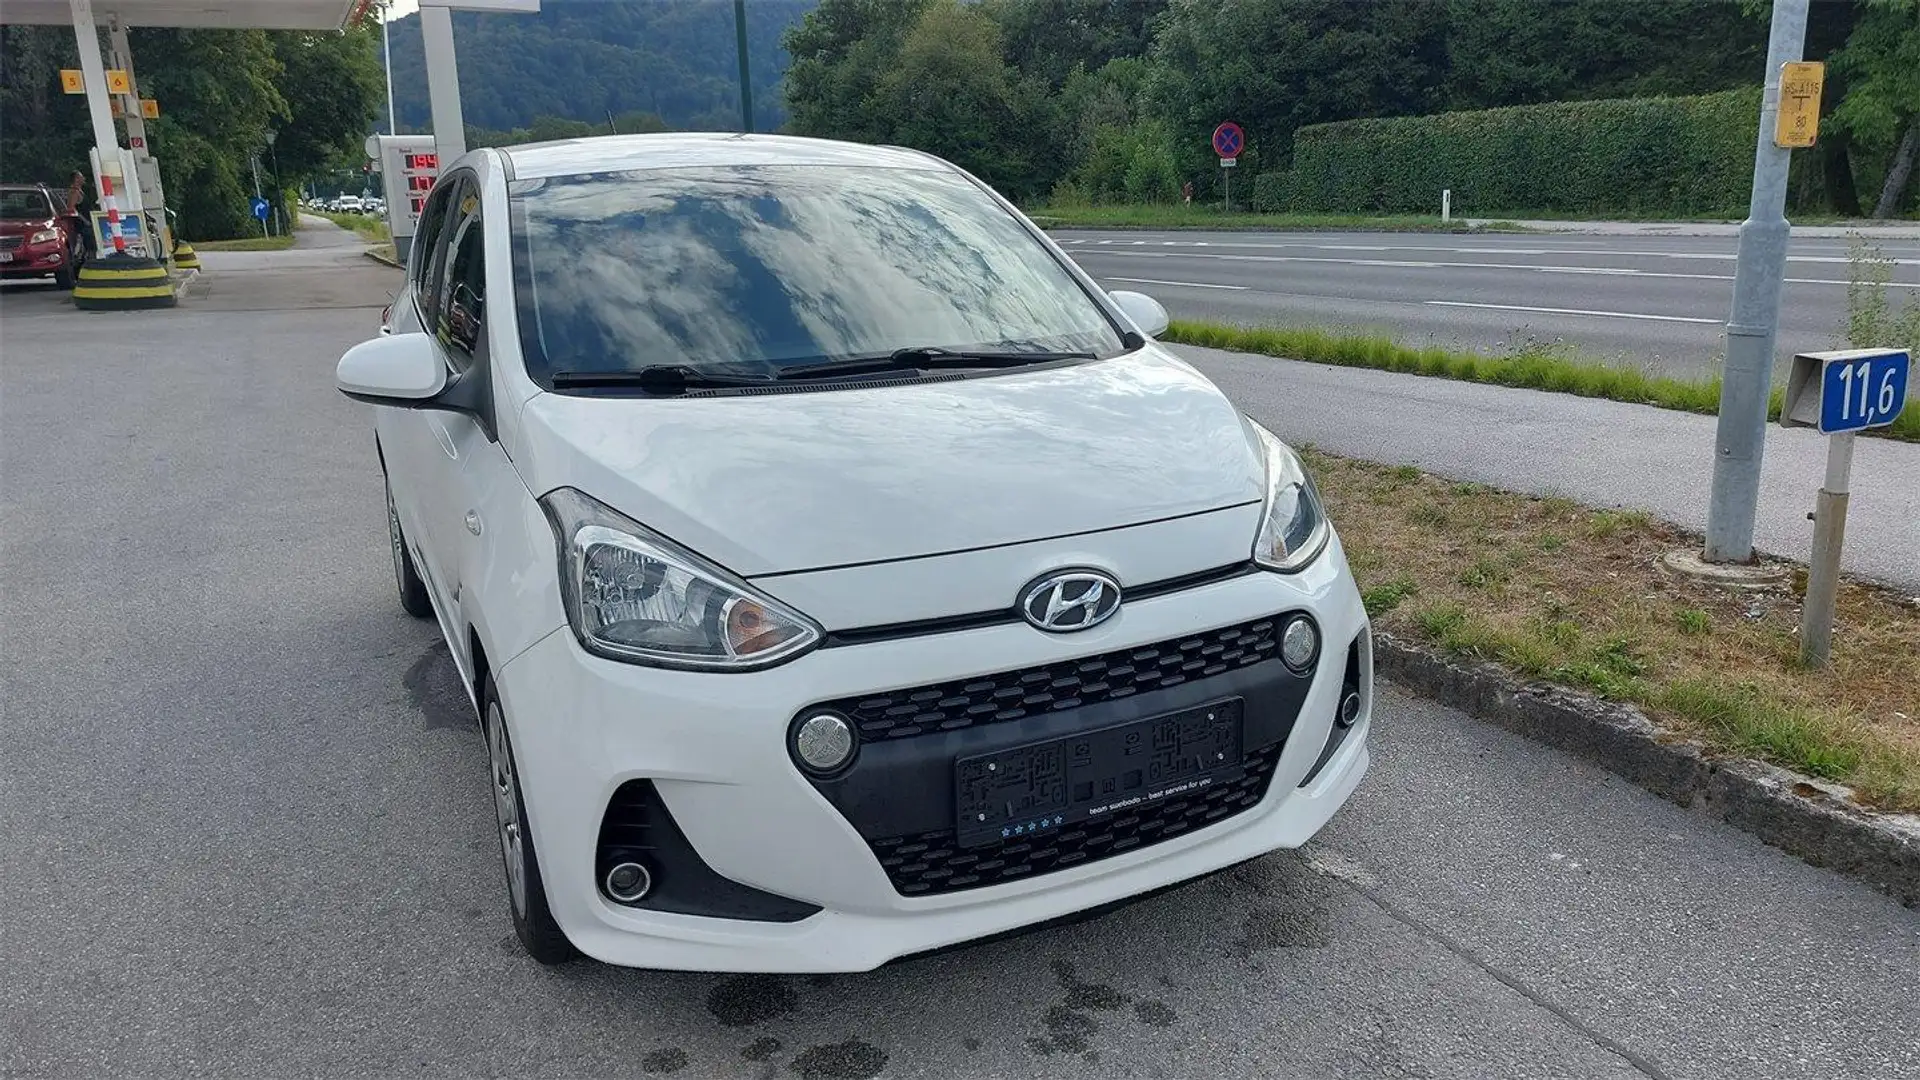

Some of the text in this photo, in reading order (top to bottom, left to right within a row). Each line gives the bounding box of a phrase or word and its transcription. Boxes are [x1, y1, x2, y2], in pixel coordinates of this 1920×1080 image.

[69, 77, 76, 87] 5
[114, 78, 122, 87] 6
[1838, 361, 1897, 424] 11,6
[1089, 805, 1108, 815] team
[1148, 790, 1164, 800] best
[1165, 784, 1188, 796] service
[1188, 781, 1198, 789] for
[1198, 777, 1212, 788] you
